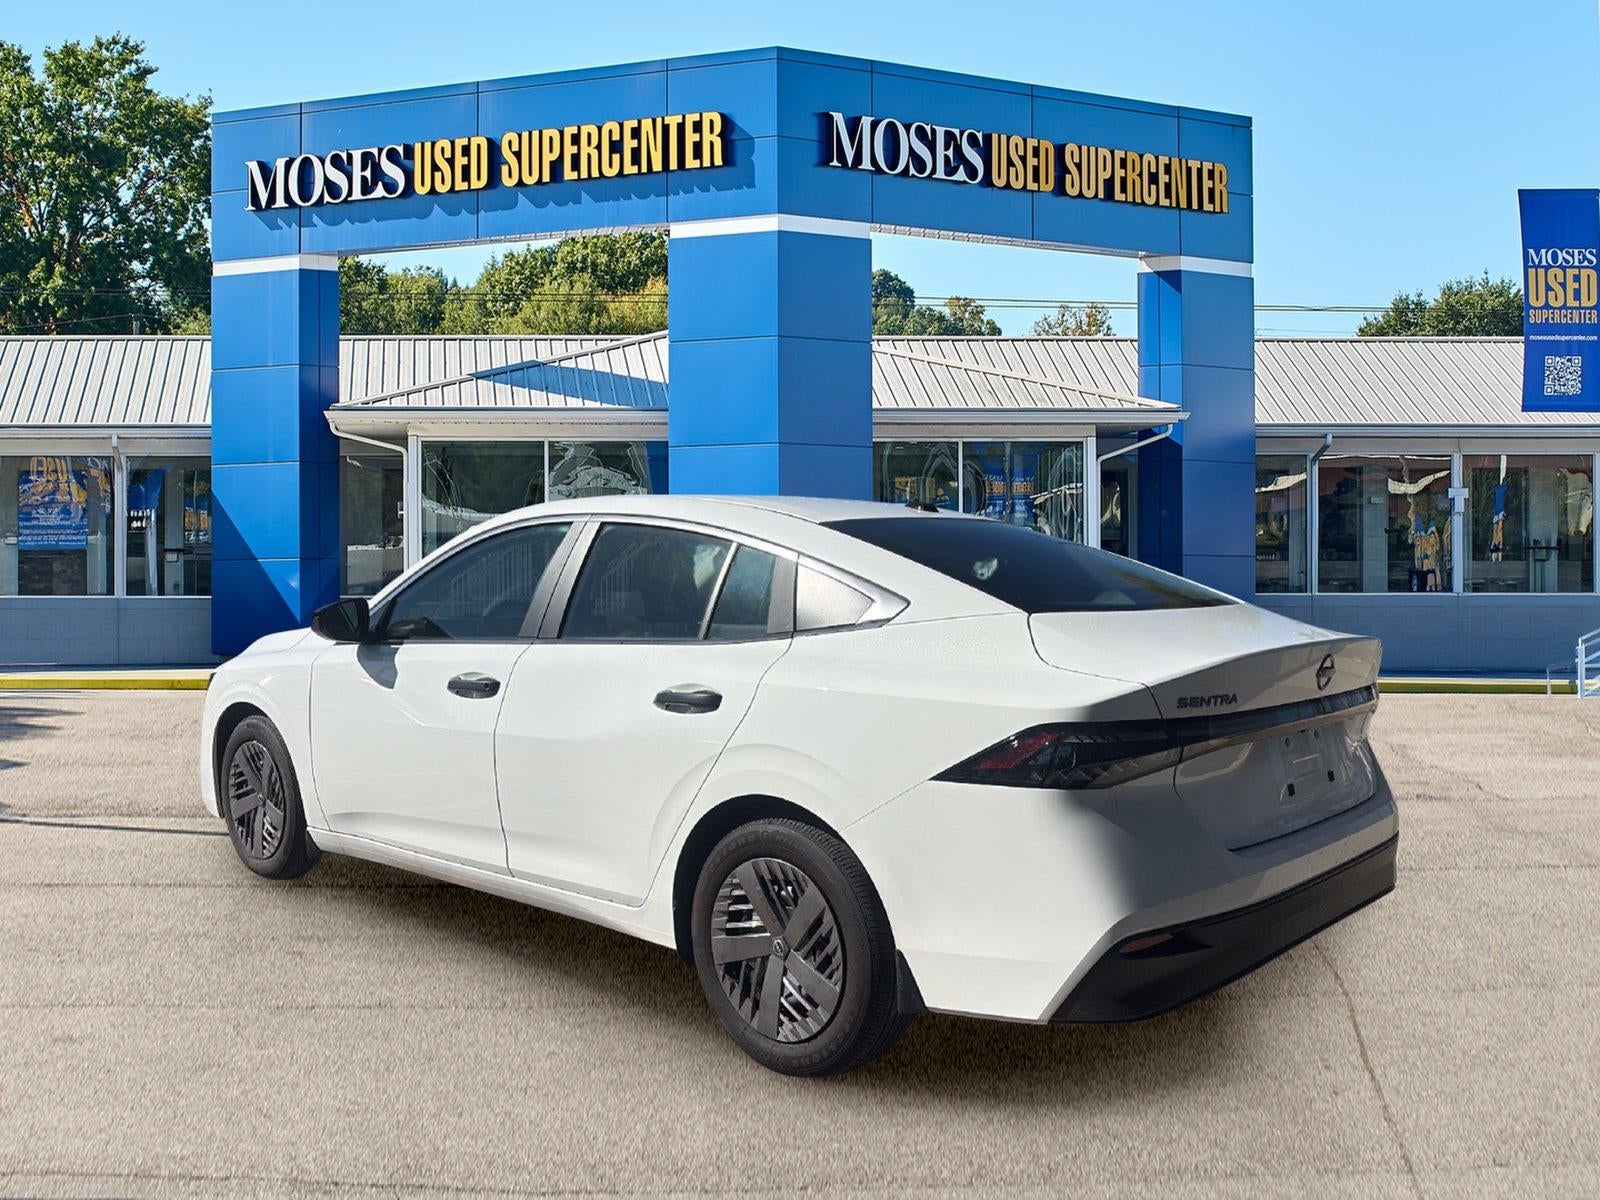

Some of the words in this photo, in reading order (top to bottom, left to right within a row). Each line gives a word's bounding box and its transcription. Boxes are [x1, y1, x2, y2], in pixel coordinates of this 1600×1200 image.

[243, 143, 407, 212] MOSES
[413, 135, 489, 196] USED
[500, 111, 724, 188] SUPERCENTER
[828, 111, 985, 184] MOSES
[991, 132, 1055, 193] USED
[1064, 142, 1230, 214] SUPERCENTER
[1527, 248, 1597, 266] MOSES
[1528, 268, 1597, 307] USED
[1529, 309, 1597, 324] SUPERCENTER
[1177, 693, 1238, 708] SENTRA
